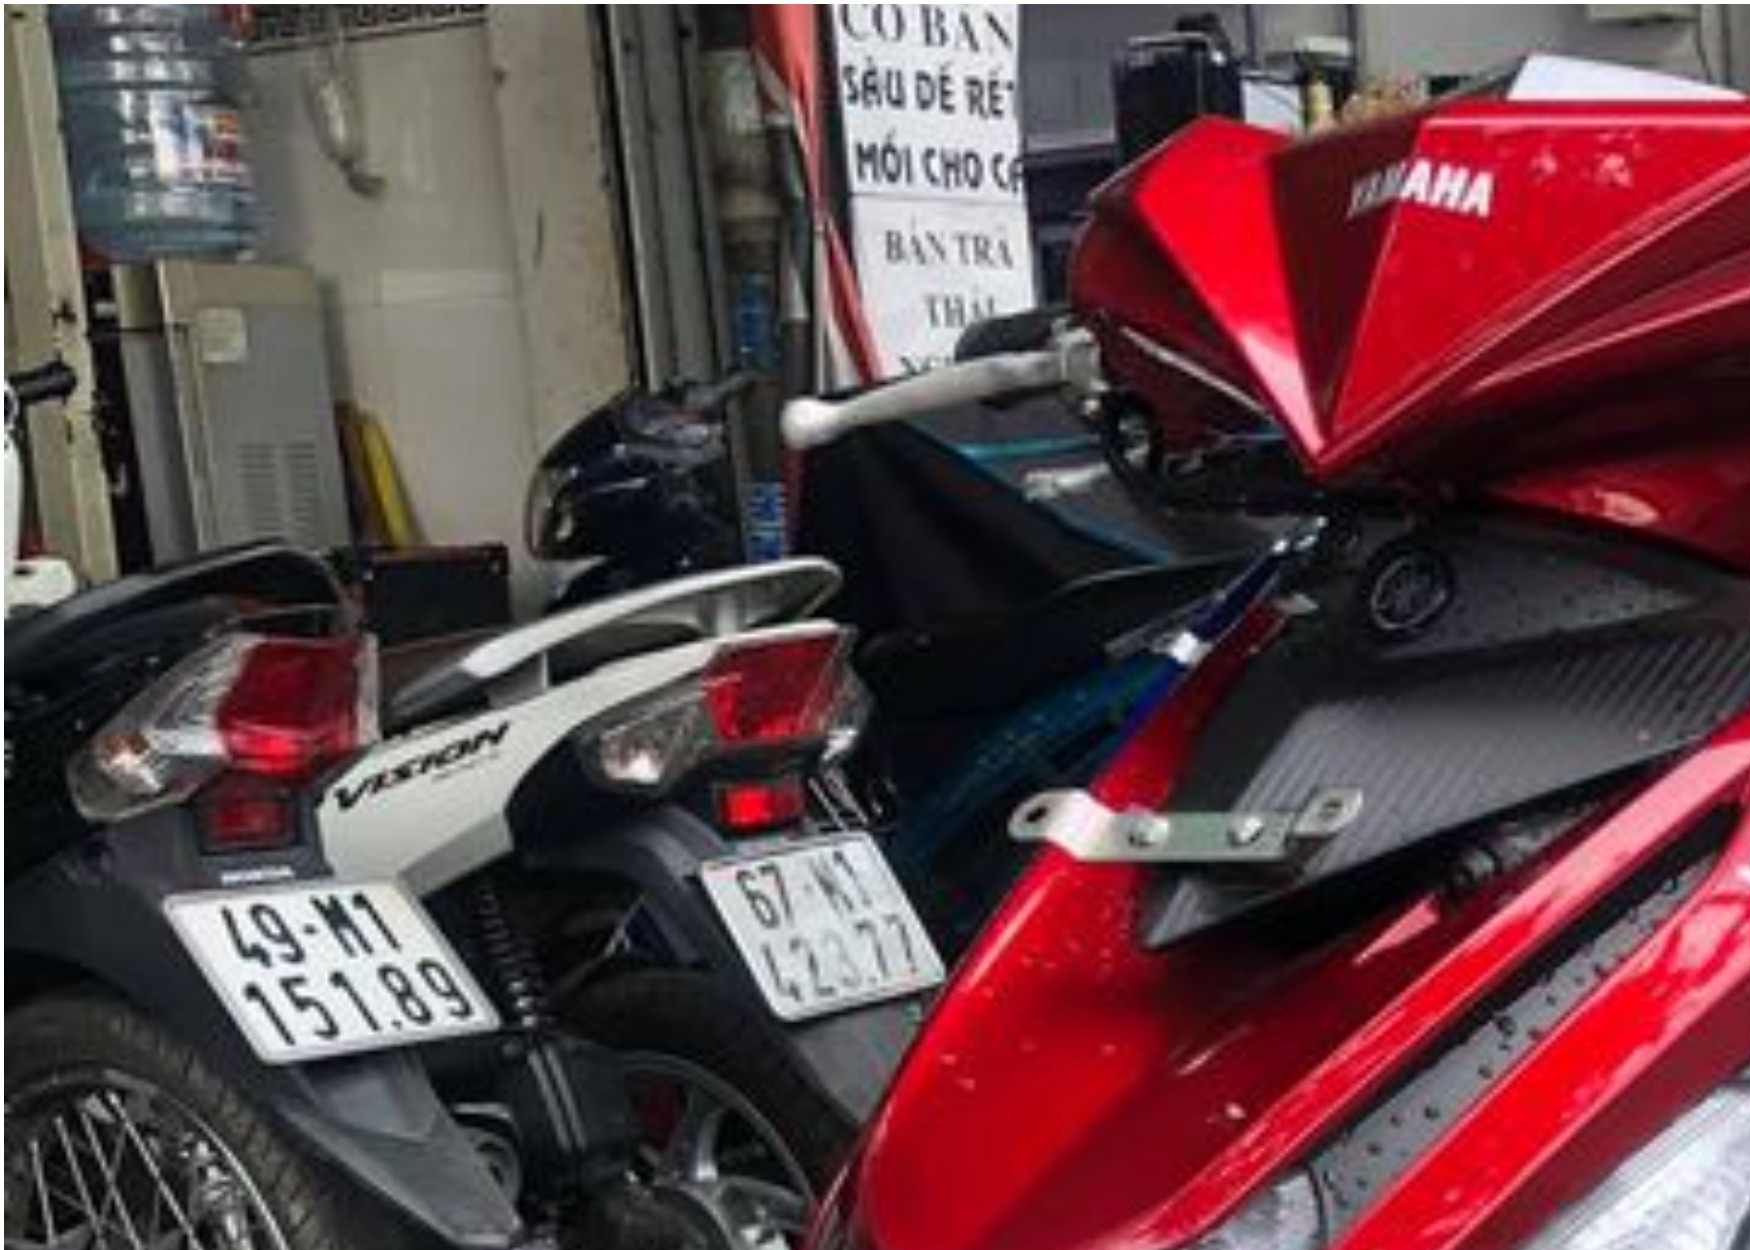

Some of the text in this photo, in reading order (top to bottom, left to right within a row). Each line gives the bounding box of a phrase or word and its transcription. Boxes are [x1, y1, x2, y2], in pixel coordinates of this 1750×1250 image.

[922, 146, 984, 190] CHO
[1347, 158, 1494, 218] YAMAHA
[334, 721, 511, 812] VISION
[220, 890, 403, 968] 49-M1
[244, 957, 475, 1047] 151.89
